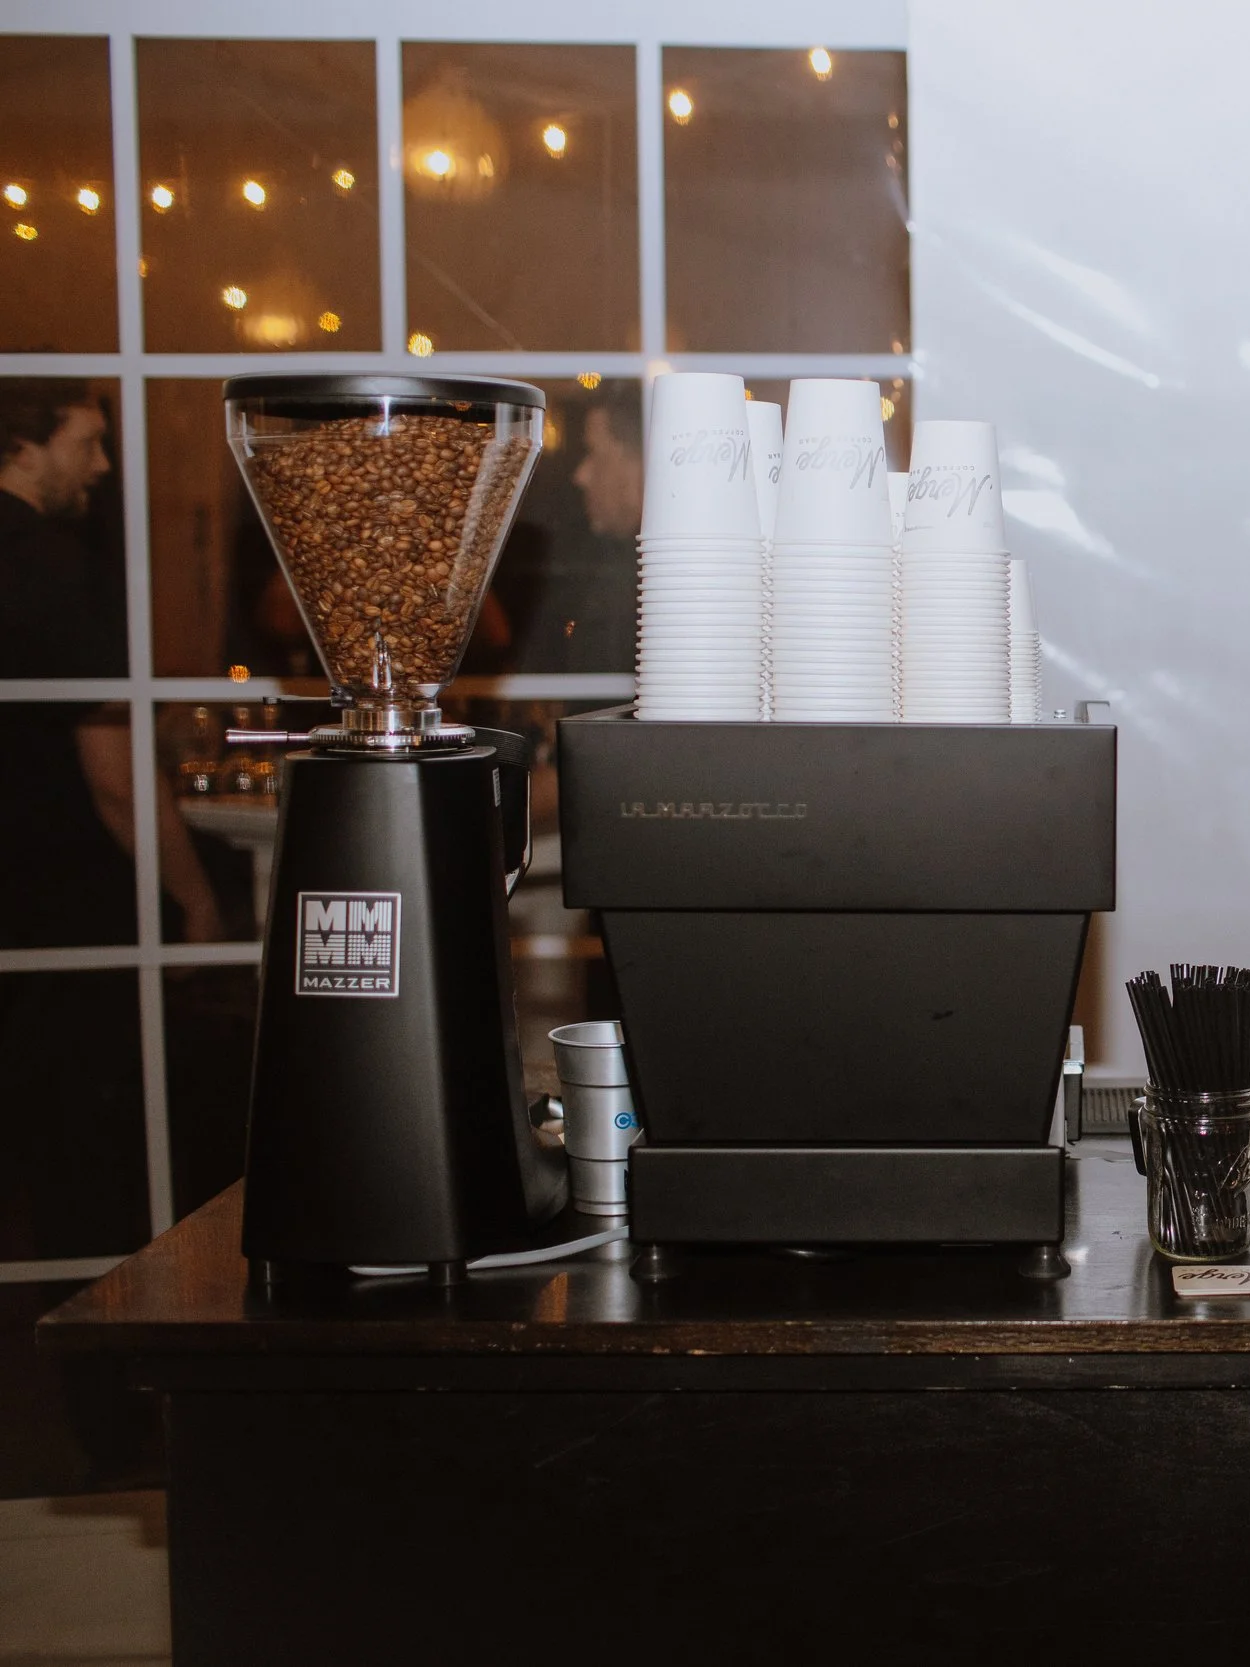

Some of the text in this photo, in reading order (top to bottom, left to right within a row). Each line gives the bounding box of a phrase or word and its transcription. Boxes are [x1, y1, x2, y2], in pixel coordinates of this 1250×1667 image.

[795, 436, 885, 490] Merge
[907, 466, 993, 518] Merge
[303, 976, 391, 990] MAZZER
